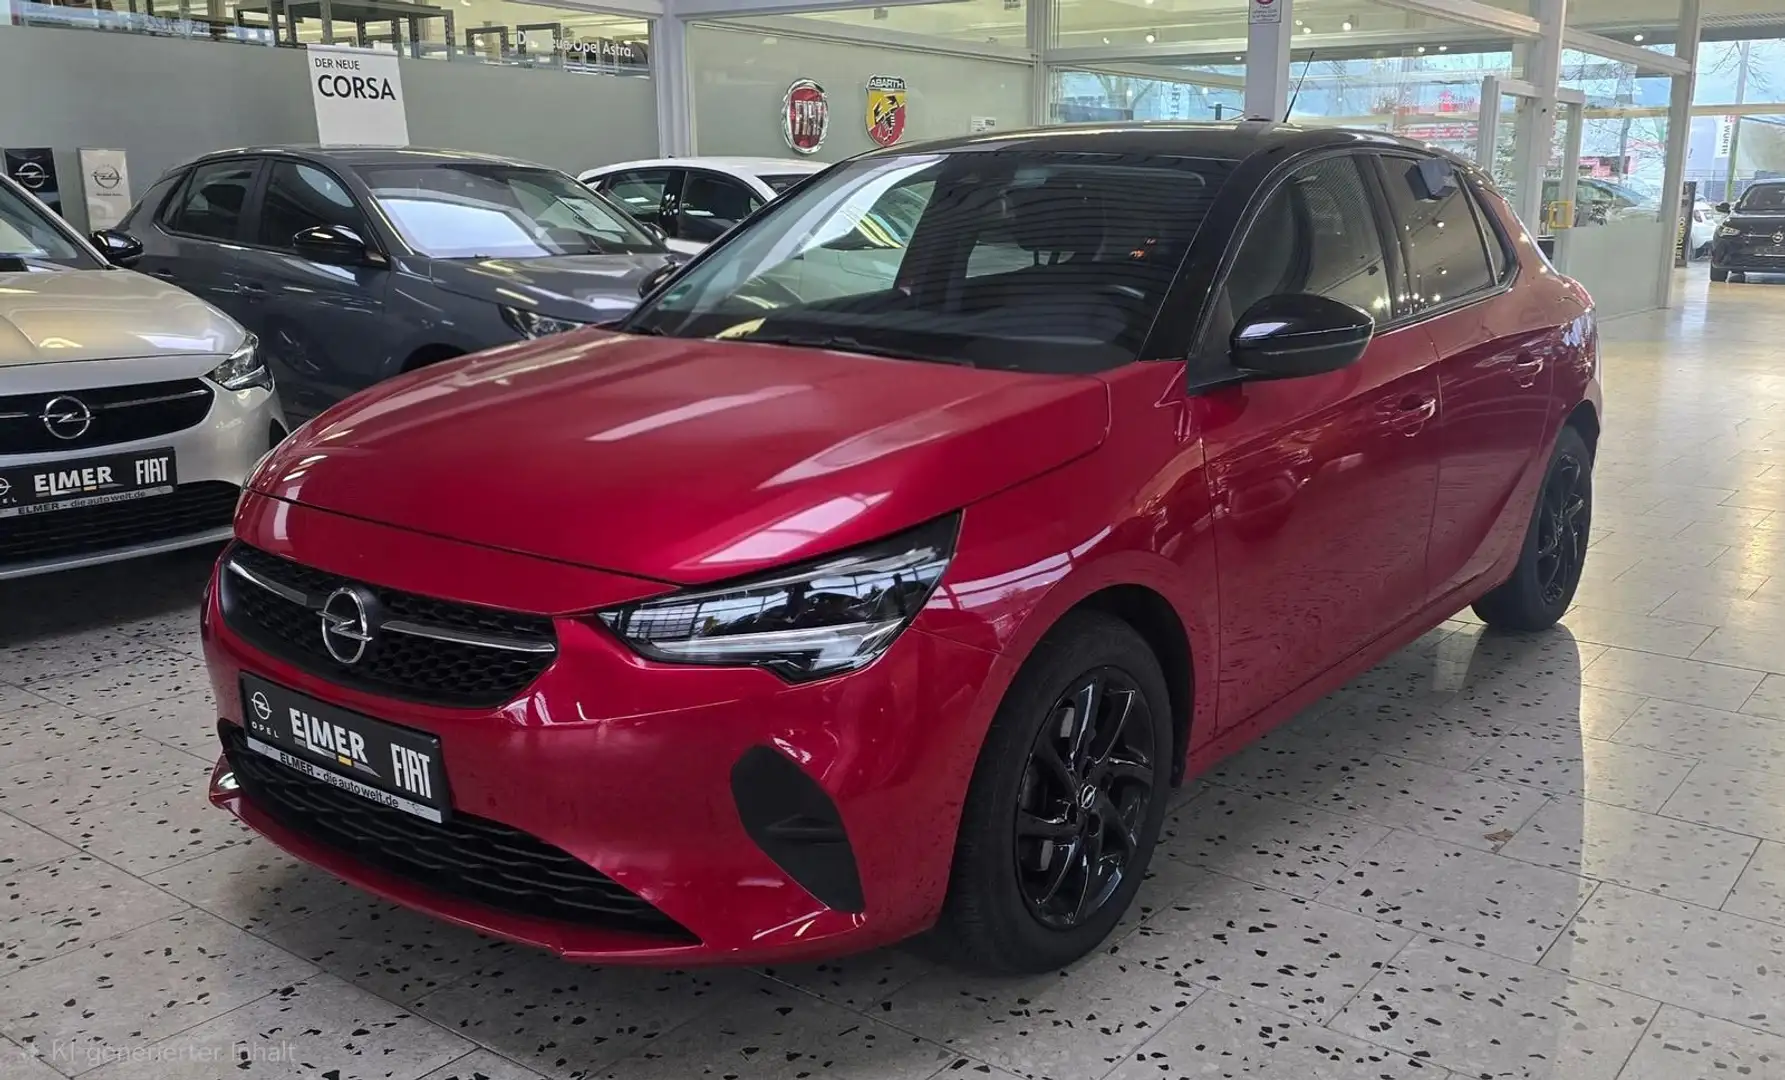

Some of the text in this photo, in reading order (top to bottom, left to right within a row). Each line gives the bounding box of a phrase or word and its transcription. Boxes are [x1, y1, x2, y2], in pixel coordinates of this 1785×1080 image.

[572, 39, 600, 55] Opel
[315, 57, 360, 70] DER NEUE
[318, 74, 396, 101] CORSA
[870, 79, 904, 90] ABARTH
[34, 466, 113, 496] ELMER
[135, 457, 168, 485] FIAT
[18, 503, 60, 515] ELMER
[251, 721, 280, 738] OPEL
[289, 708, 368, 764] ELMER
[279, 752, 314, 776] ELMER
[390, 743, 432, 799] FIAT
